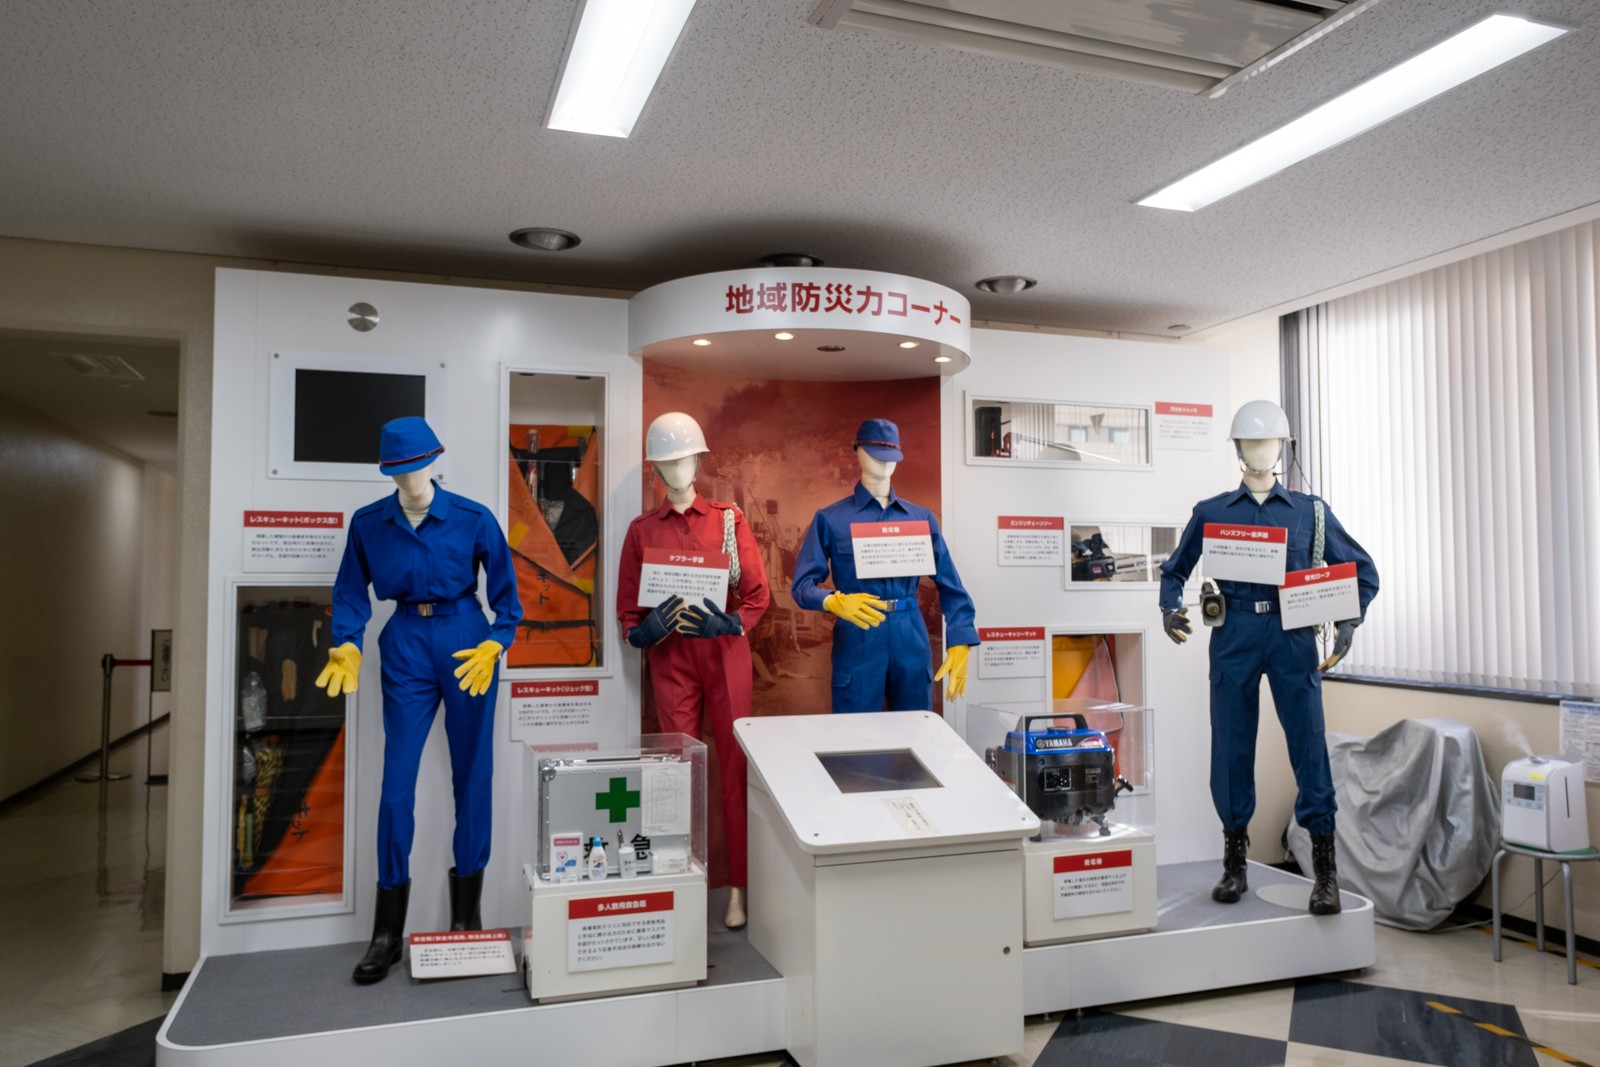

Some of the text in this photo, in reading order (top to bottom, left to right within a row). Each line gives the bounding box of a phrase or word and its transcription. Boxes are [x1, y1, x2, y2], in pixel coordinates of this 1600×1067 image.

[725, 282, 961, 325] 地域防災力コーナー
[669, 554, 704, 564] ケブラー手袋
[1044, 738, 1073, 748] YAMAHA
[597, 900, 647, 912] 多人数用救急箱
